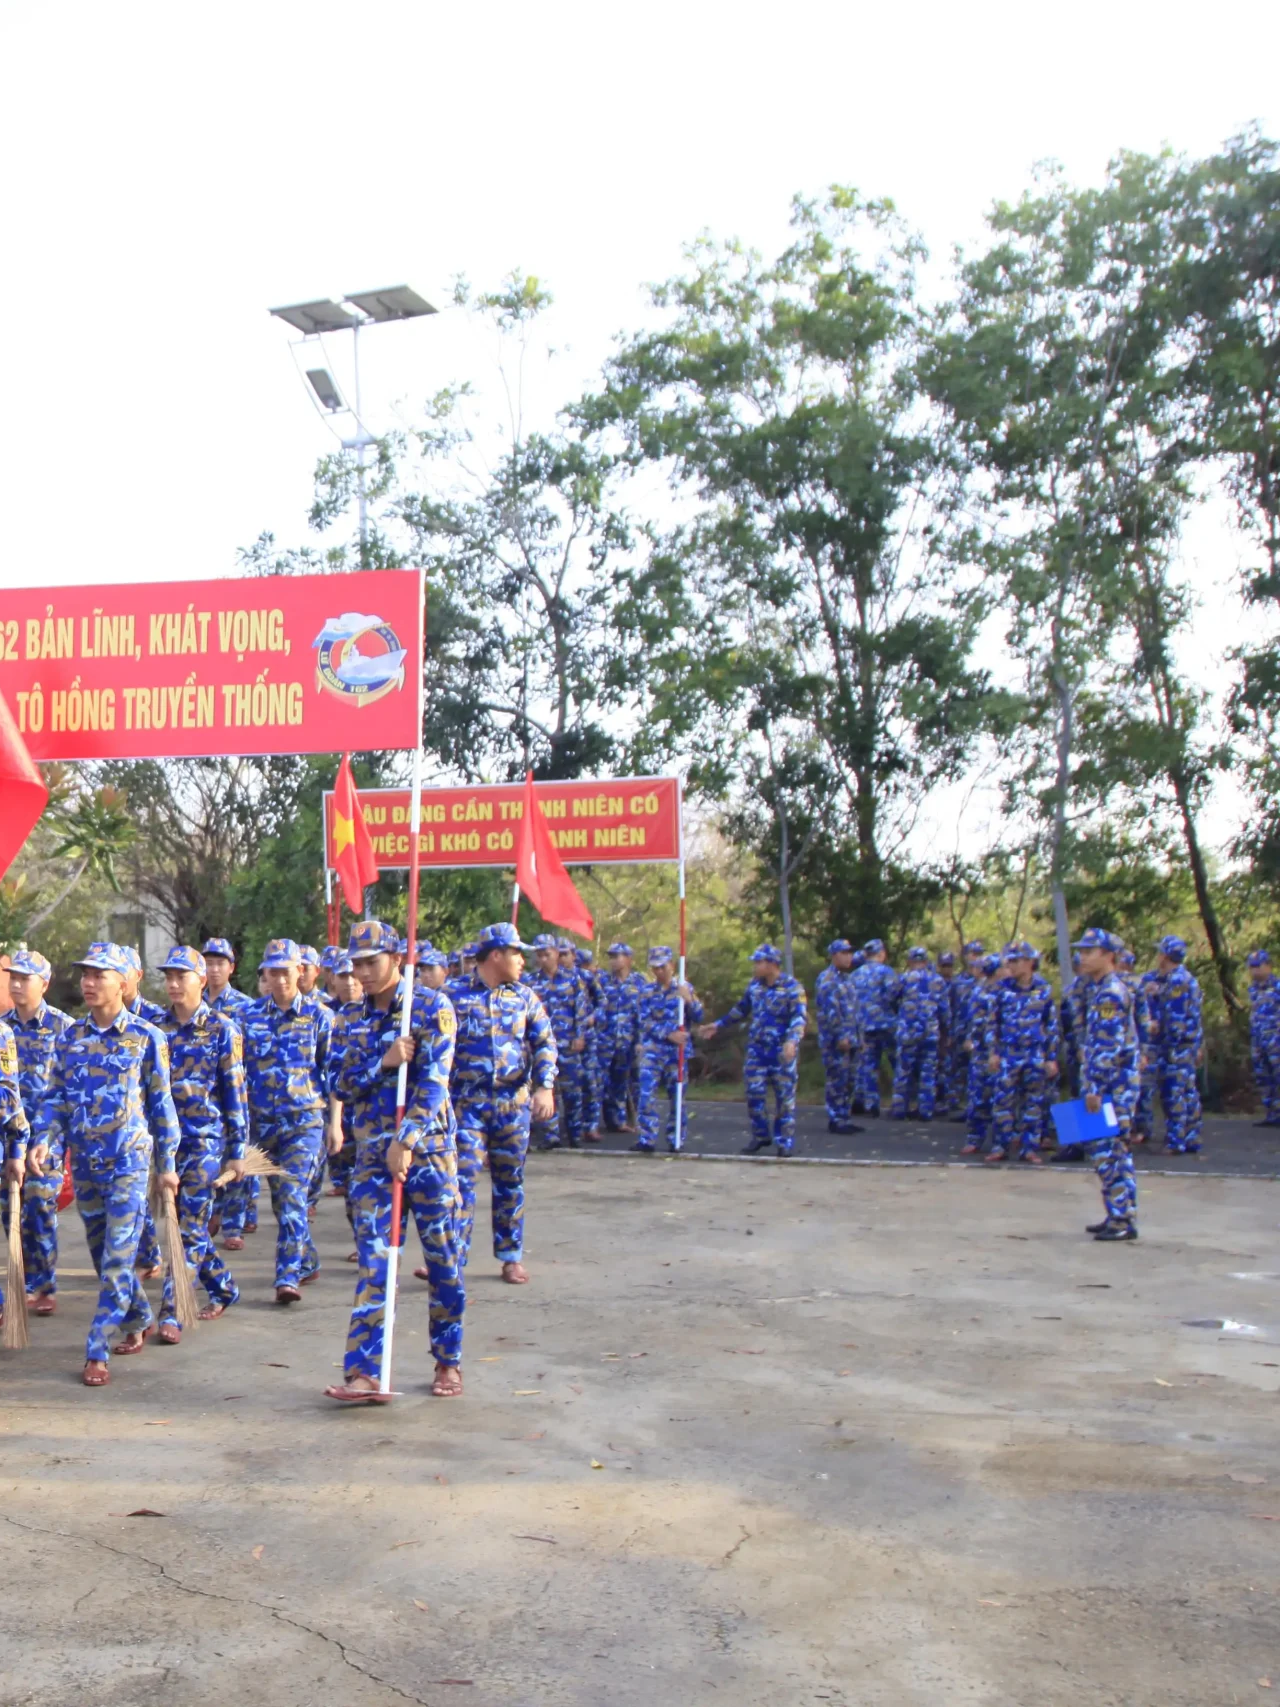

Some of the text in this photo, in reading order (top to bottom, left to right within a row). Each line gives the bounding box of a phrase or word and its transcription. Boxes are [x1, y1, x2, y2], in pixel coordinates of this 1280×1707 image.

[25, 604, 74, 660] BẢN
[81, 608, 142, 662] LĨNH,
[149, 603, 212, 656] KHÁT
[218, 608, 291, 662] VỌNG,
[16, 682, 44, 733] TÔ
[51, 675, 116, 732] HỒNG
[122, 671, 215, 730] TRUYỀN
[222, 668, 303, 727] THỐNG
[362, 803, 387, 825] ÂU
[499, 798, 567, 820] THNH
[572, 793, 623, 818] NIÊN
[630, 791, 659, 816] CÓ
[440, 828, 480, 852] KHÓ
[487, 827, 514, 851] CÓ
[594, 824, 646, 848] NIÊN
